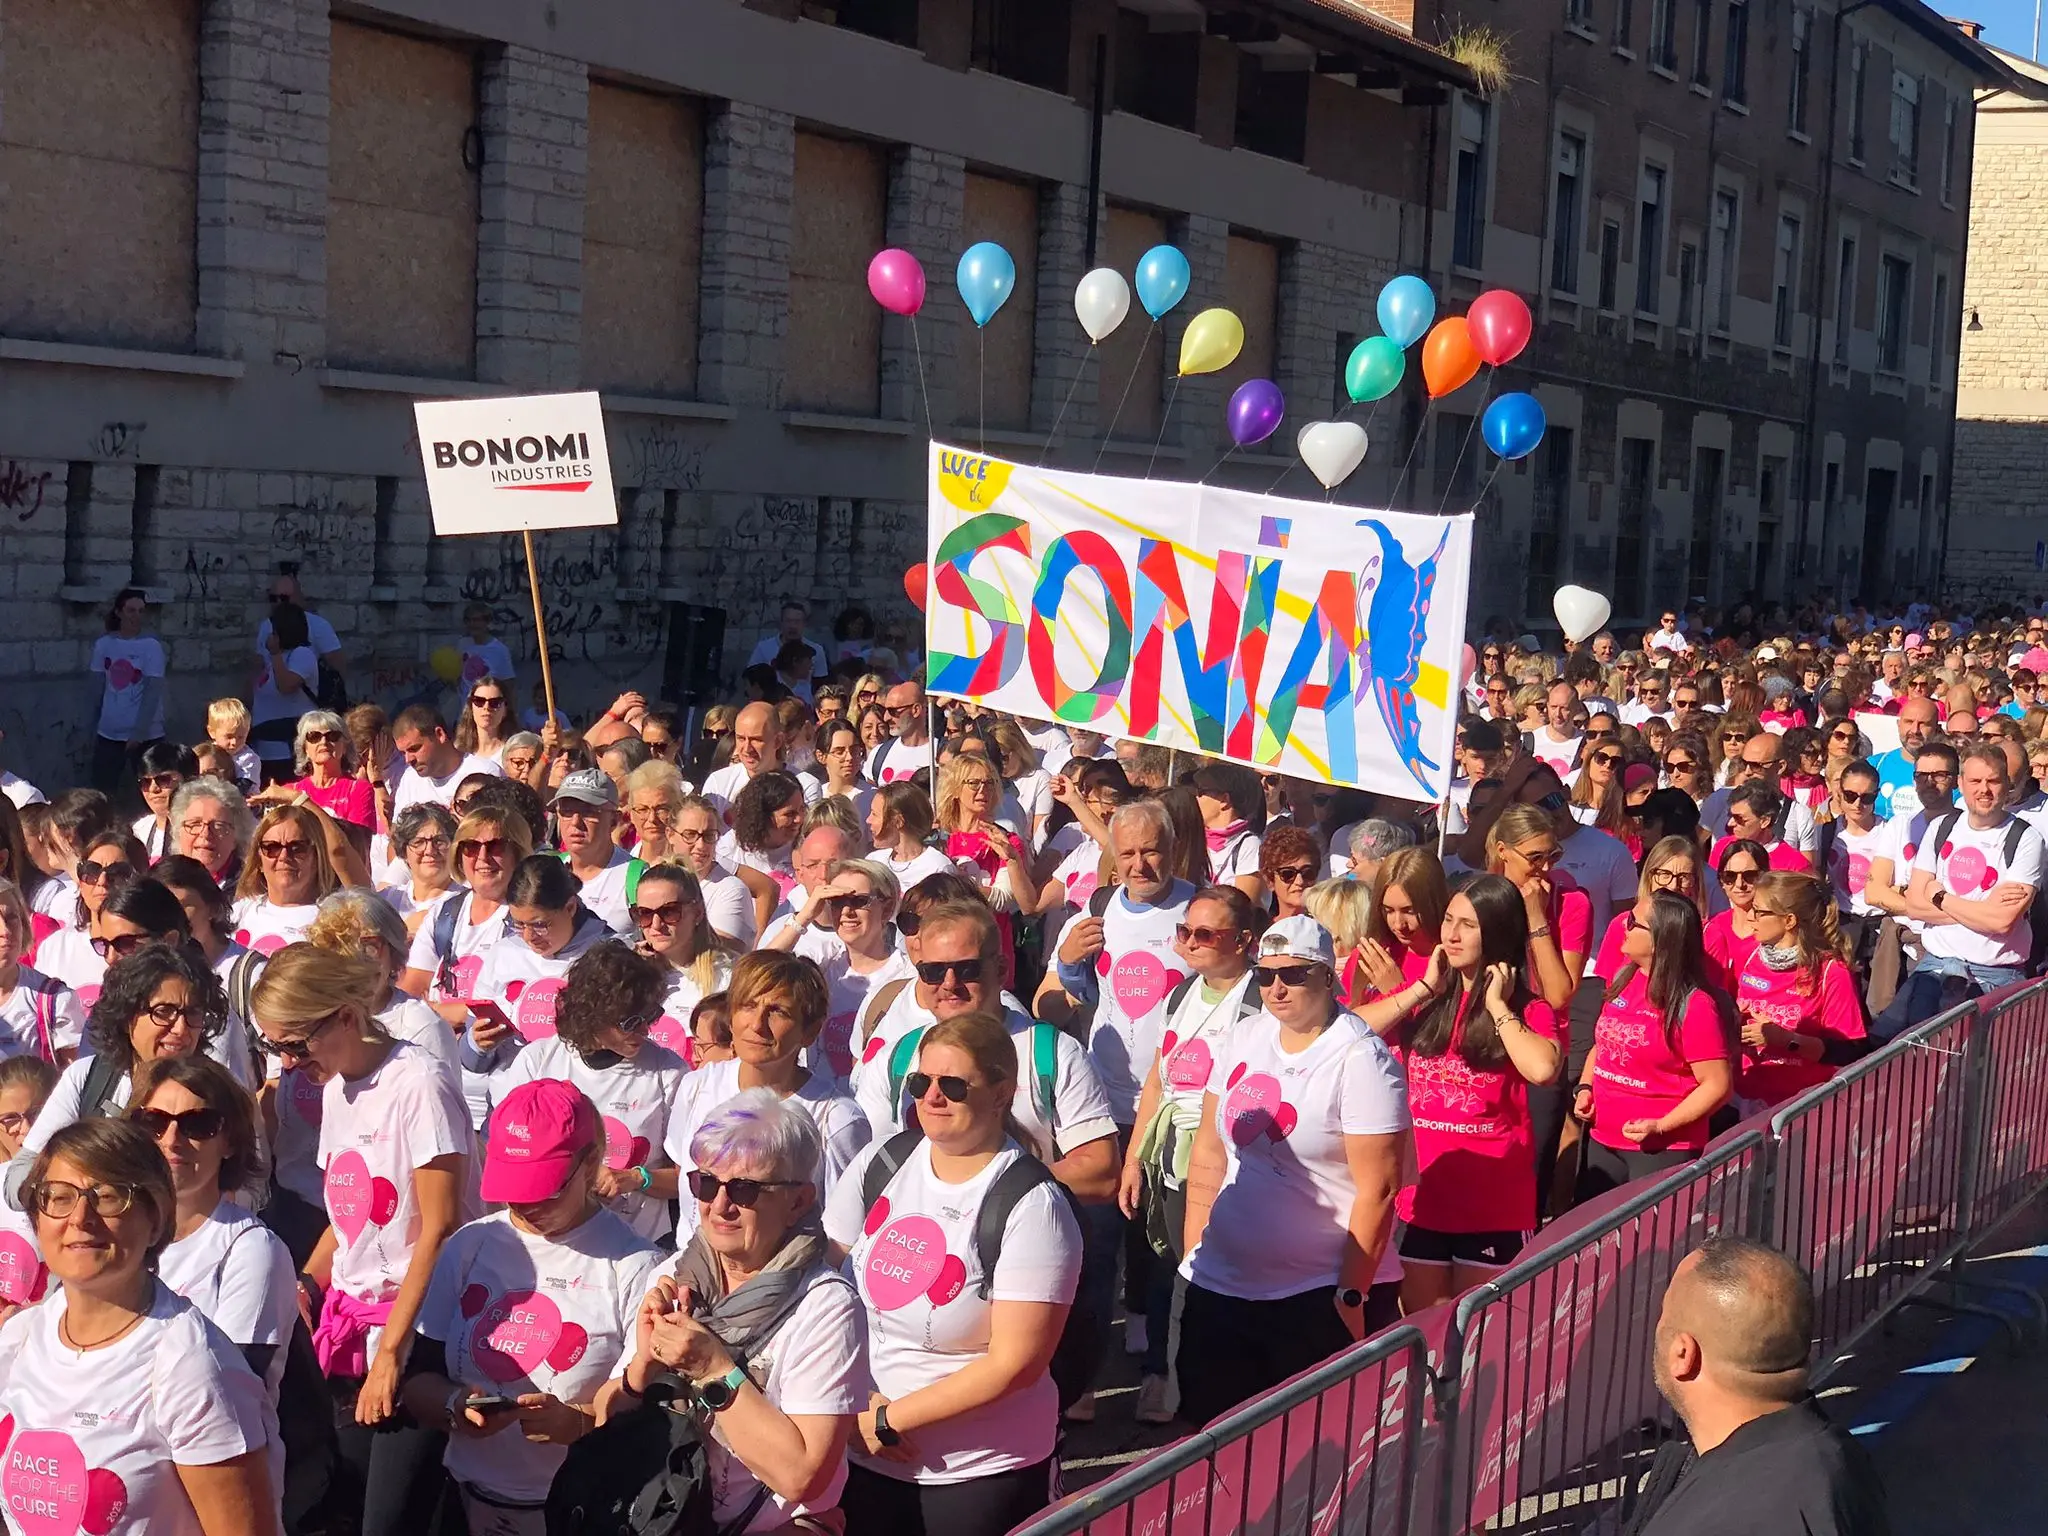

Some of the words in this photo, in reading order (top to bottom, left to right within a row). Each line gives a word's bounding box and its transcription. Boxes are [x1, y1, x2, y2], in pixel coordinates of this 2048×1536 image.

[432, 432, 590, 469] BONOMI
[491, 463, 593, 483] INDUSTRIES
[941, 451, 991, 481] LUCE
[448, 966, 474, 979] ACE
[1117, 966, 1149, 976] RACE
[1117, 987, 1149, 997] CURE
[521, 1013, 556, 1026] CURE
[1169, 1071, 1193, 1082] CURE
[1237, 1083, 1266, 1100] RACE
[1227, 1105, 1255, 1125] CURE
[329, 1173, 355, 1187] RACE
[385, 1198, 395, 1217] 2025
[885, 1229, 929, 1256] RACE
[878, 1243, 907, 1265] FOR
[910, 1254, 937, 1275] THE
[870, 1258, 914, 1285] CURE
[946, 1281, 962, 1299] 2025
[489, 1307, 538, 1325] RACE
[477, 1335, 528, 1356] CURE
[567, 1345, 584, 1364] 2025
[12, 1451, 60, 1477] RACE
[10, 1473, 42, 1494] FOR
[47, 1480, 80, 1503] THE
[11, 1494, 60, 1520] CURE
[105, 1500, 123, 1524] 2025
